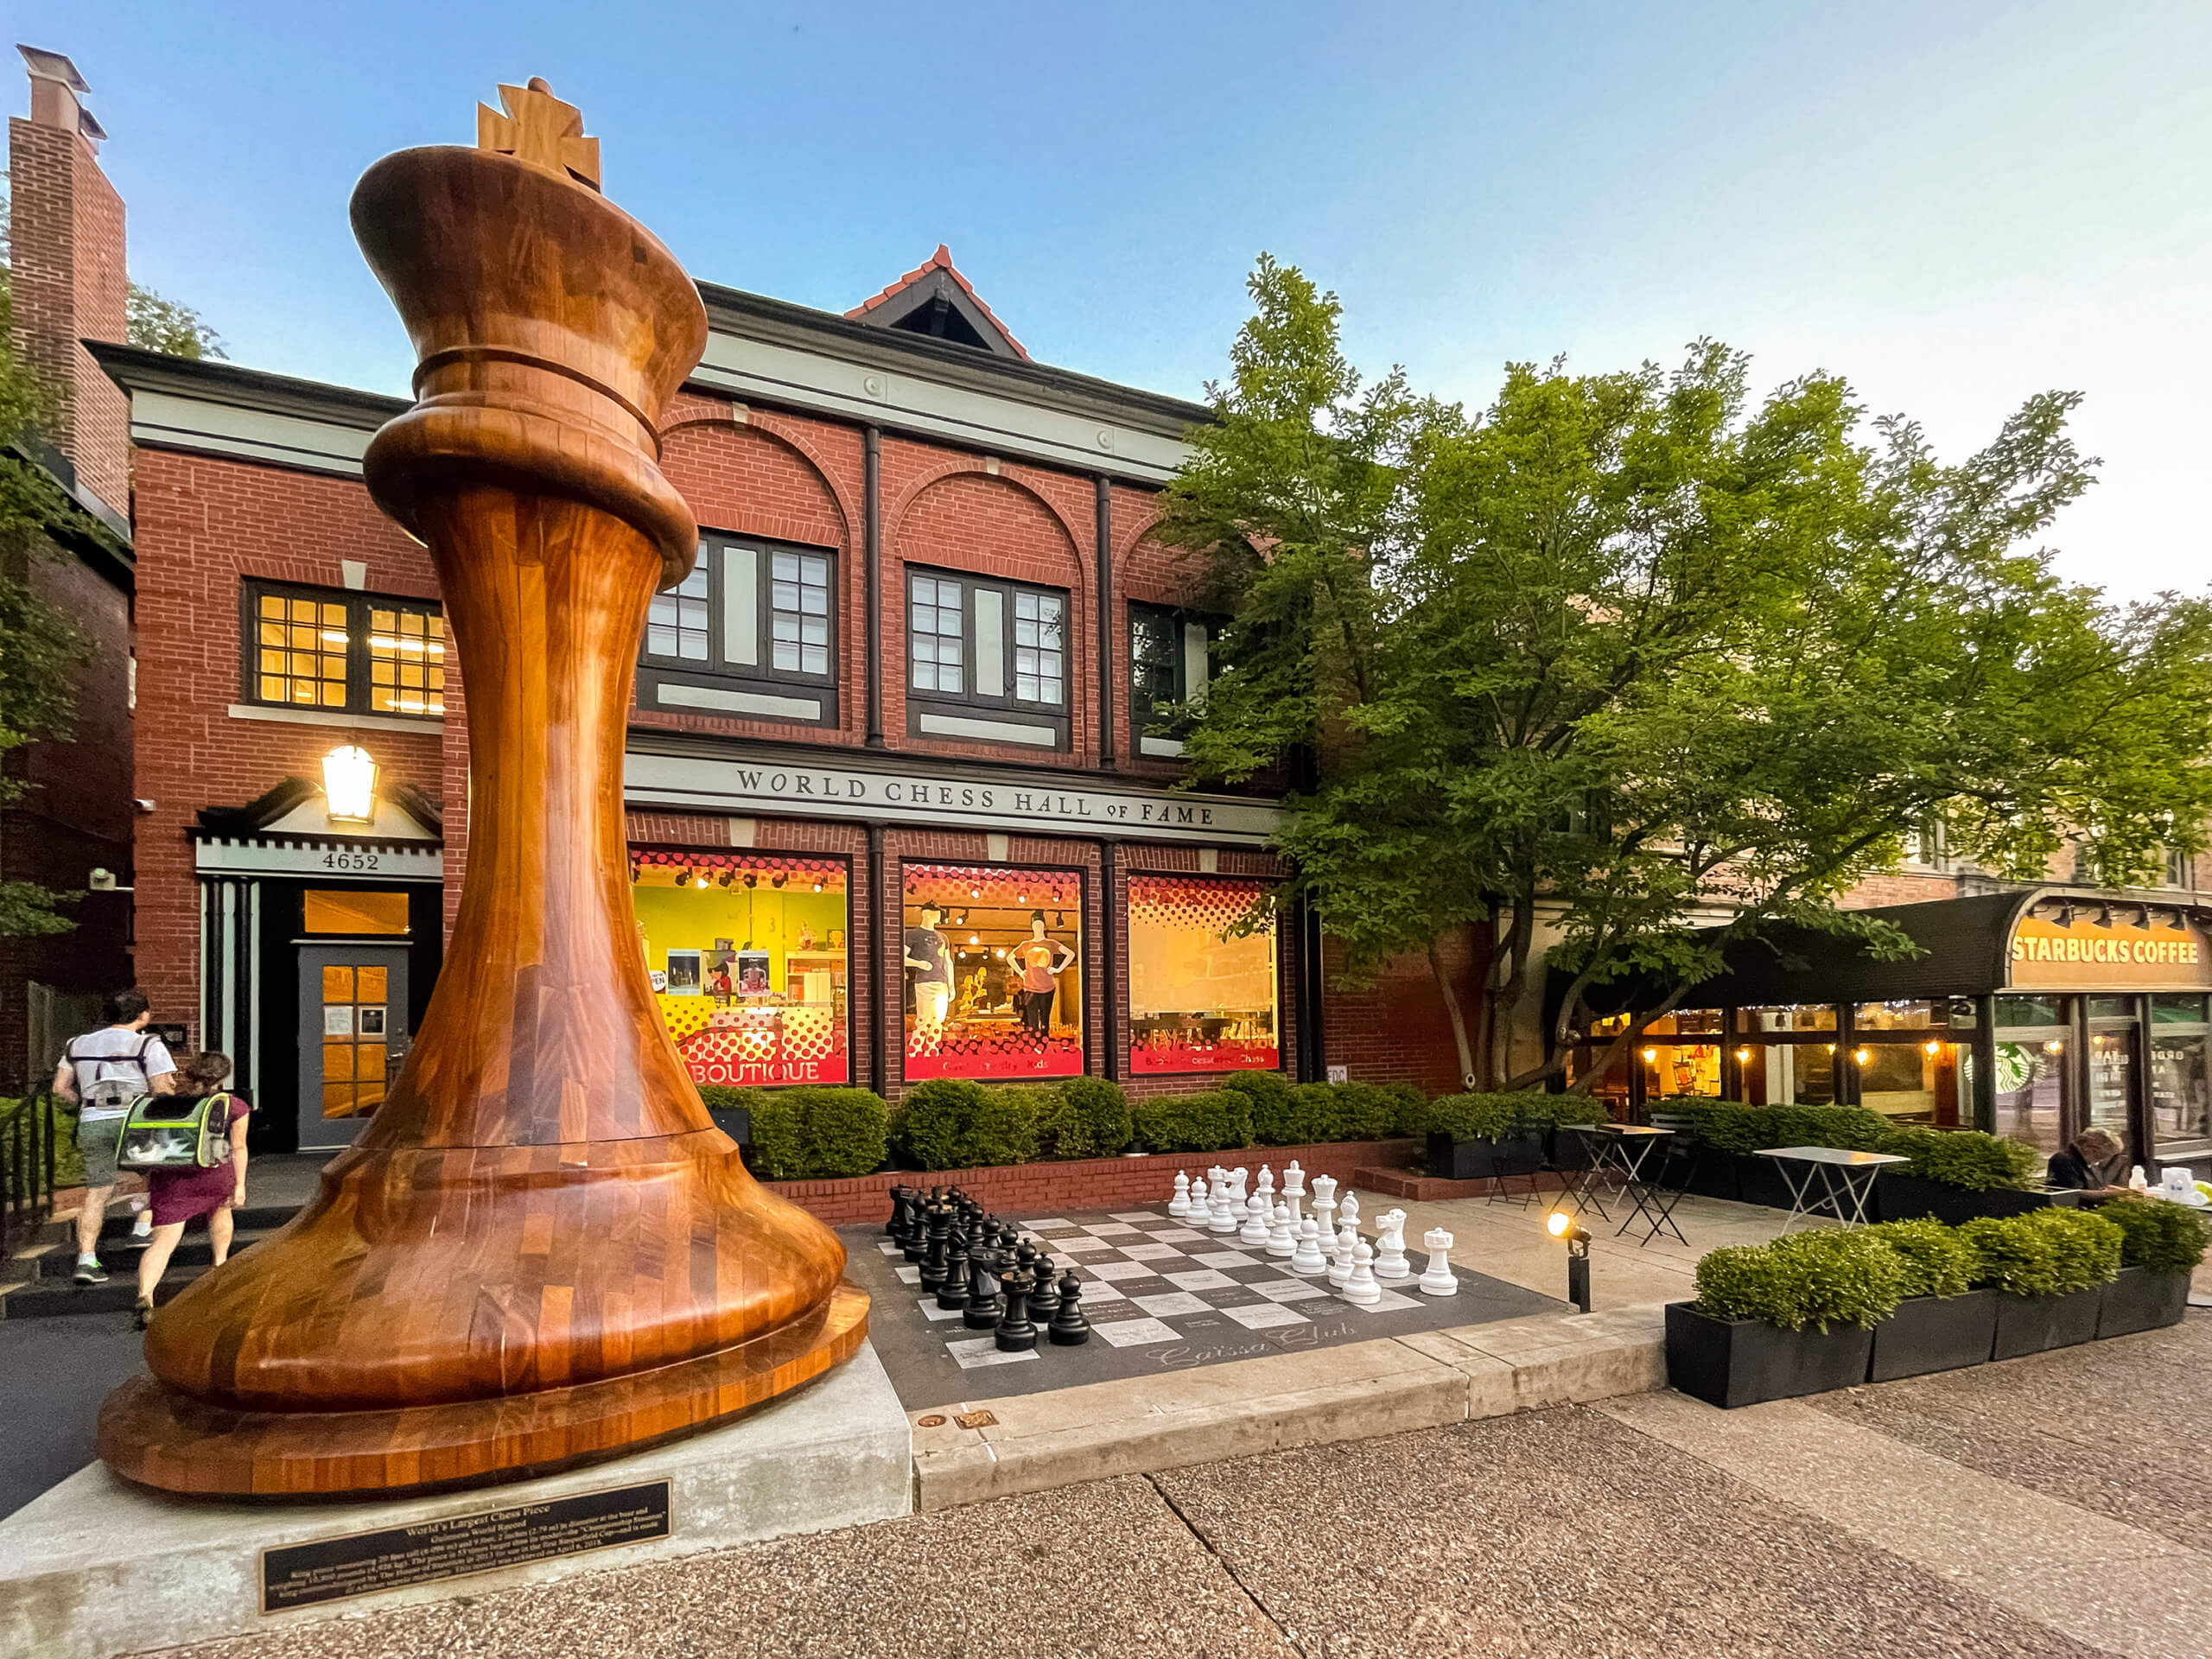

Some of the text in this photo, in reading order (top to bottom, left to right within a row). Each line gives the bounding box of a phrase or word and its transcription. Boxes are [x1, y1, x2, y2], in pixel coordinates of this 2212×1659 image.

[737, 770, 866, 798] WORLD
[885, 783, 994, 808] CHESS
[1014, 793, 1091, 816] HALL
[1141, 804, 1213, 825] FAME
[322, 853, 378, 870] 4652
[2012, 936, 2199, 964] STARBUCKS COFFEE
[1265, 1322, 1357, 1345] Club
[406, 1505, 551, 1537] World's Largest Chess Piece
